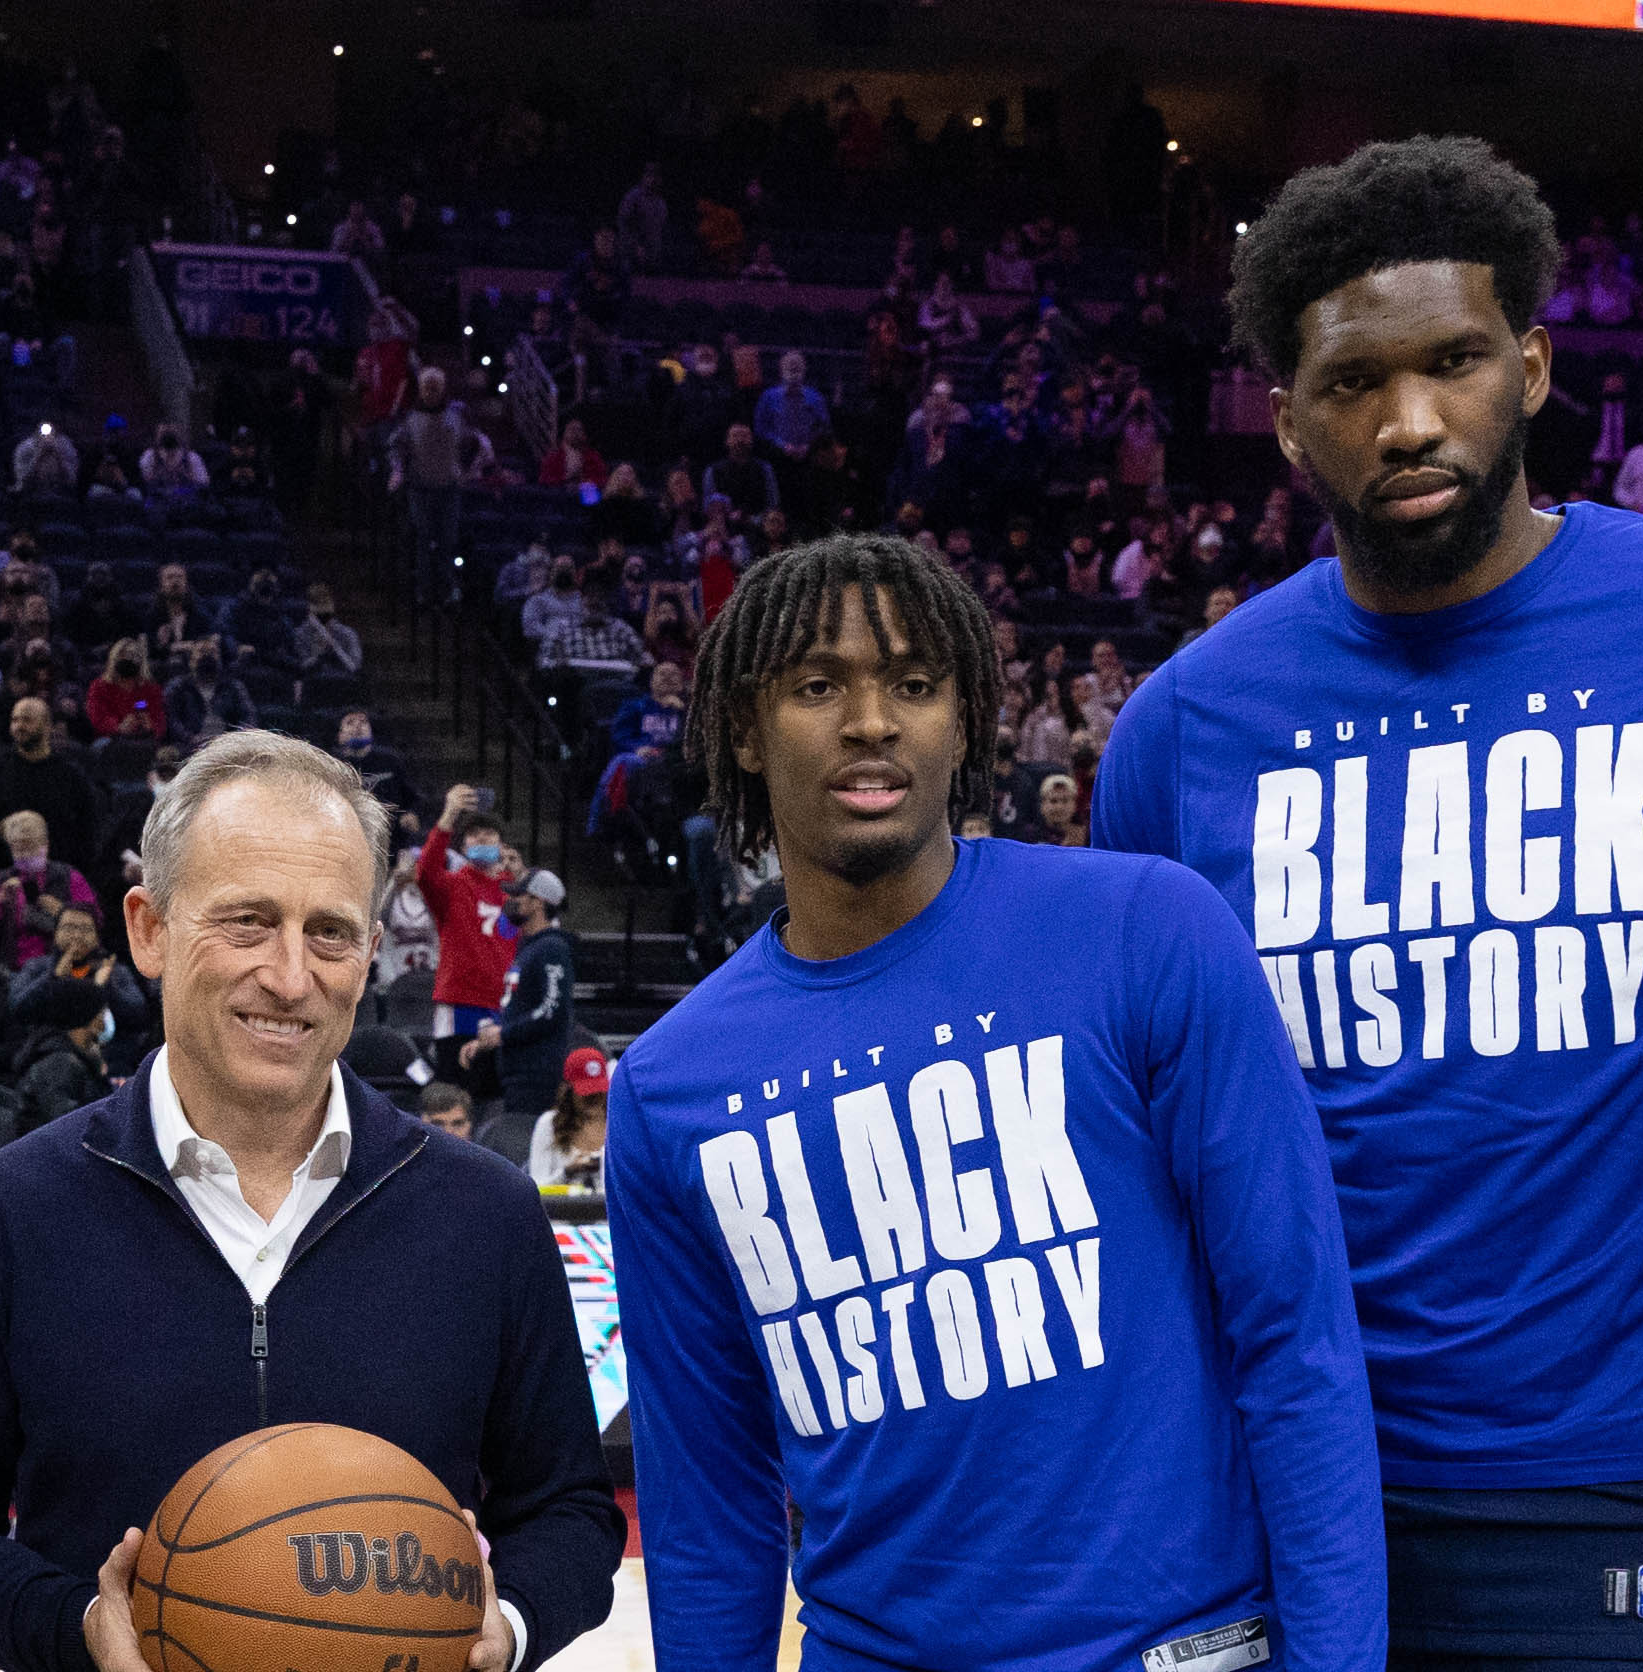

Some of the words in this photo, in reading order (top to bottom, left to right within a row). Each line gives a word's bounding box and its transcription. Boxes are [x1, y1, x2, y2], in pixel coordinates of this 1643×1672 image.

[178, 261, 320, 296] GEICO
[276, 304, 338, 338] 124
[1296, 711, 1470, 749] BUILT
[1528, 689, 1594, 713] BY
[727, 1046, 884, 1114] BUILT
[935, 1012, 995, 1045] BY
[699, 1035, 1098, 1315] BLACK
[762, 1238, 1104, 1436] HISTORY
[288, 1531, 482, 1609] Wilson
[1178, 1647, 1188, 1657] L
